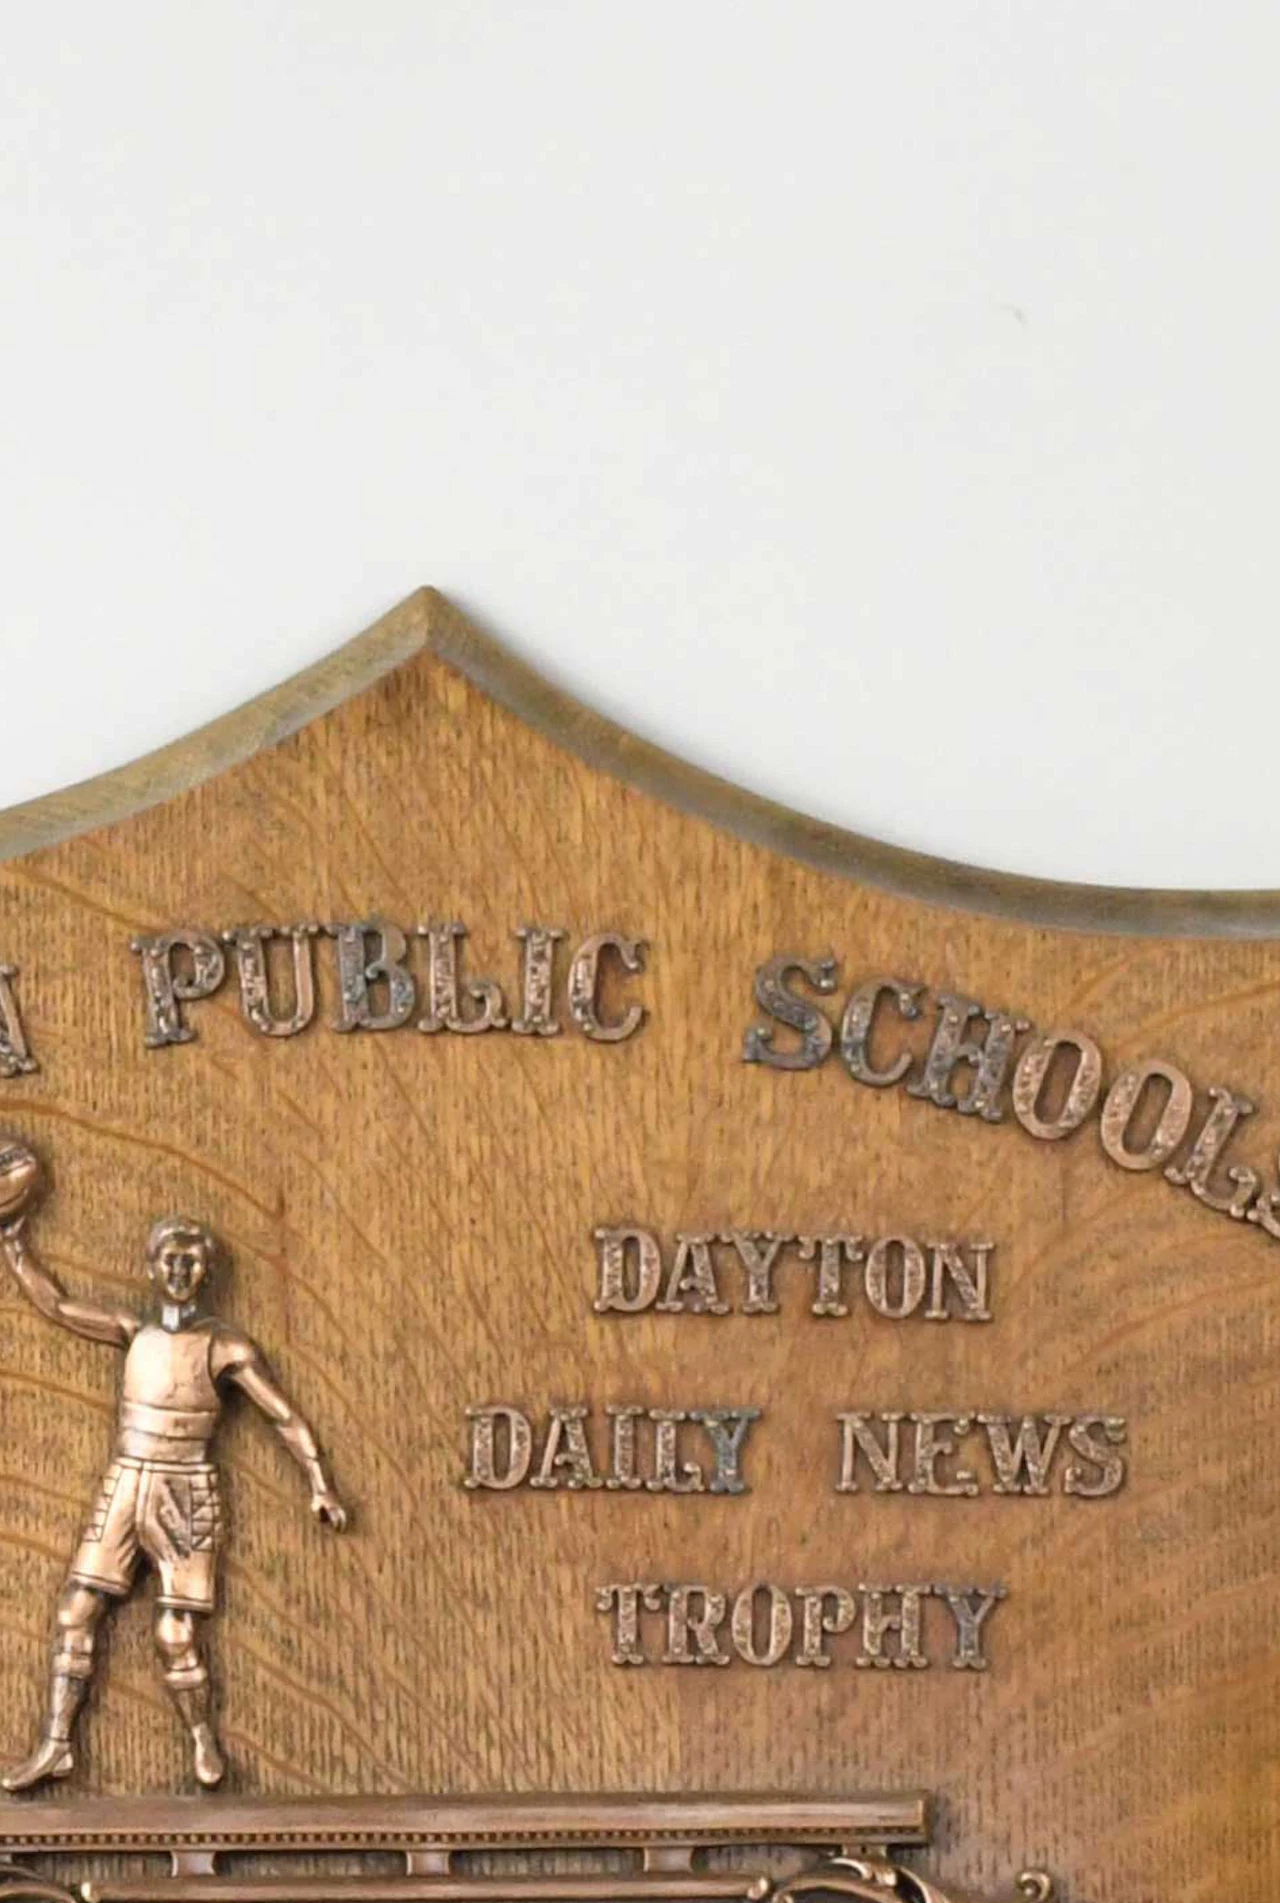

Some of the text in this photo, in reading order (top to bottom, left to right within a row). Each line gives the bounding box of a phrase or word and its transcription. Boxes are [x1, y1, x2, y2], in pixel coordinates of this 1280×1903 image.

[130, 918, 650, 1048] PUBLIC
[593, 1226, 995, 1322] DAYTON
[463, 1404, 1129, 1498] DAILY NEWS
[595, 1580, 1008, 1669] TROPHY
